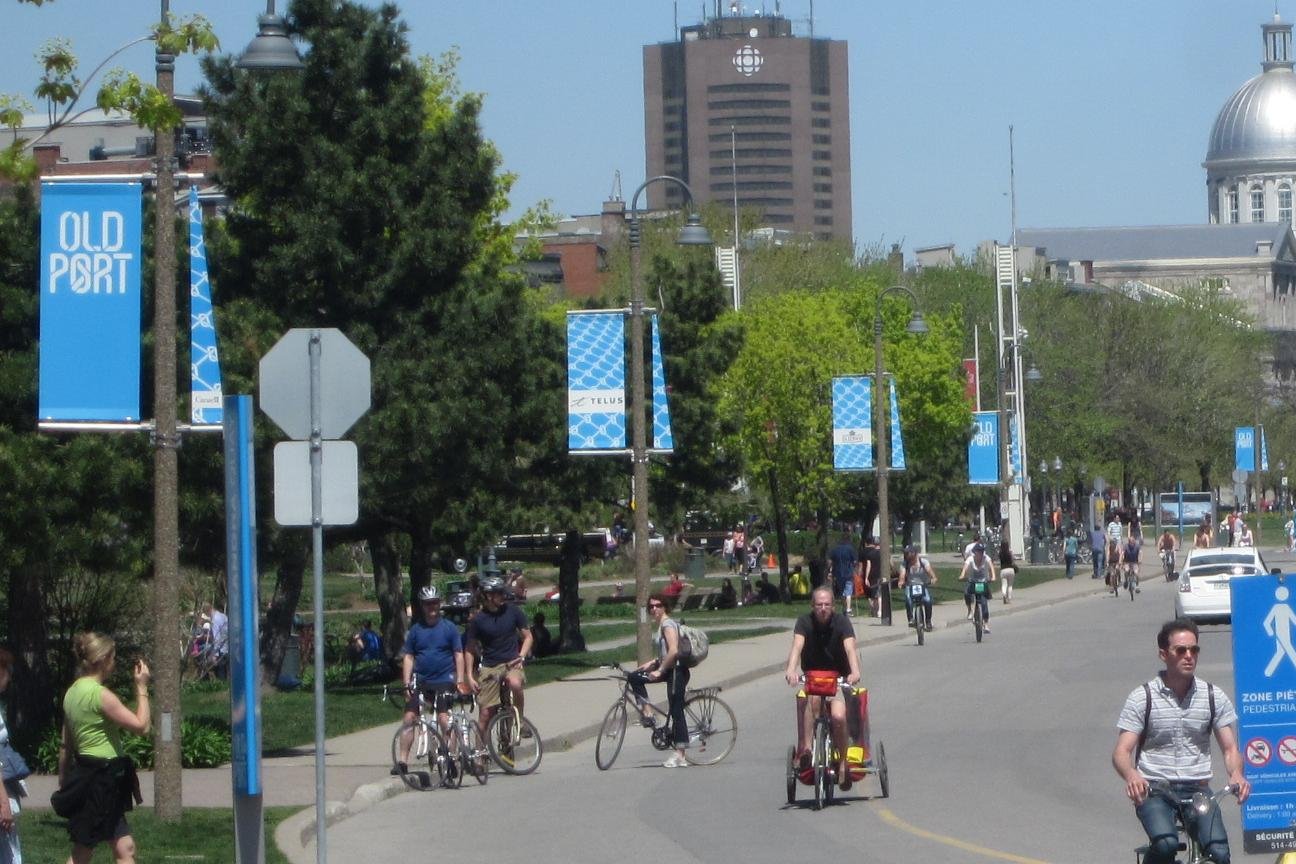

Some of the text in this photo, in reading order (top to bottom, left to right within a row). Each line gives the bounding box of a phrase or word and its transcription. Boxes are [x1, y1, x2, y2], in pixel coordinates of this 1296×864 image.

[59, 211, 124, 251] OLD
[50, 253, 133, 294] PORT
[590, 397, 623, 405] TELUS
[1242, 692, 1272, 702] ZONE
[1255, 831, 1295, 840] SÉCURITÉ
